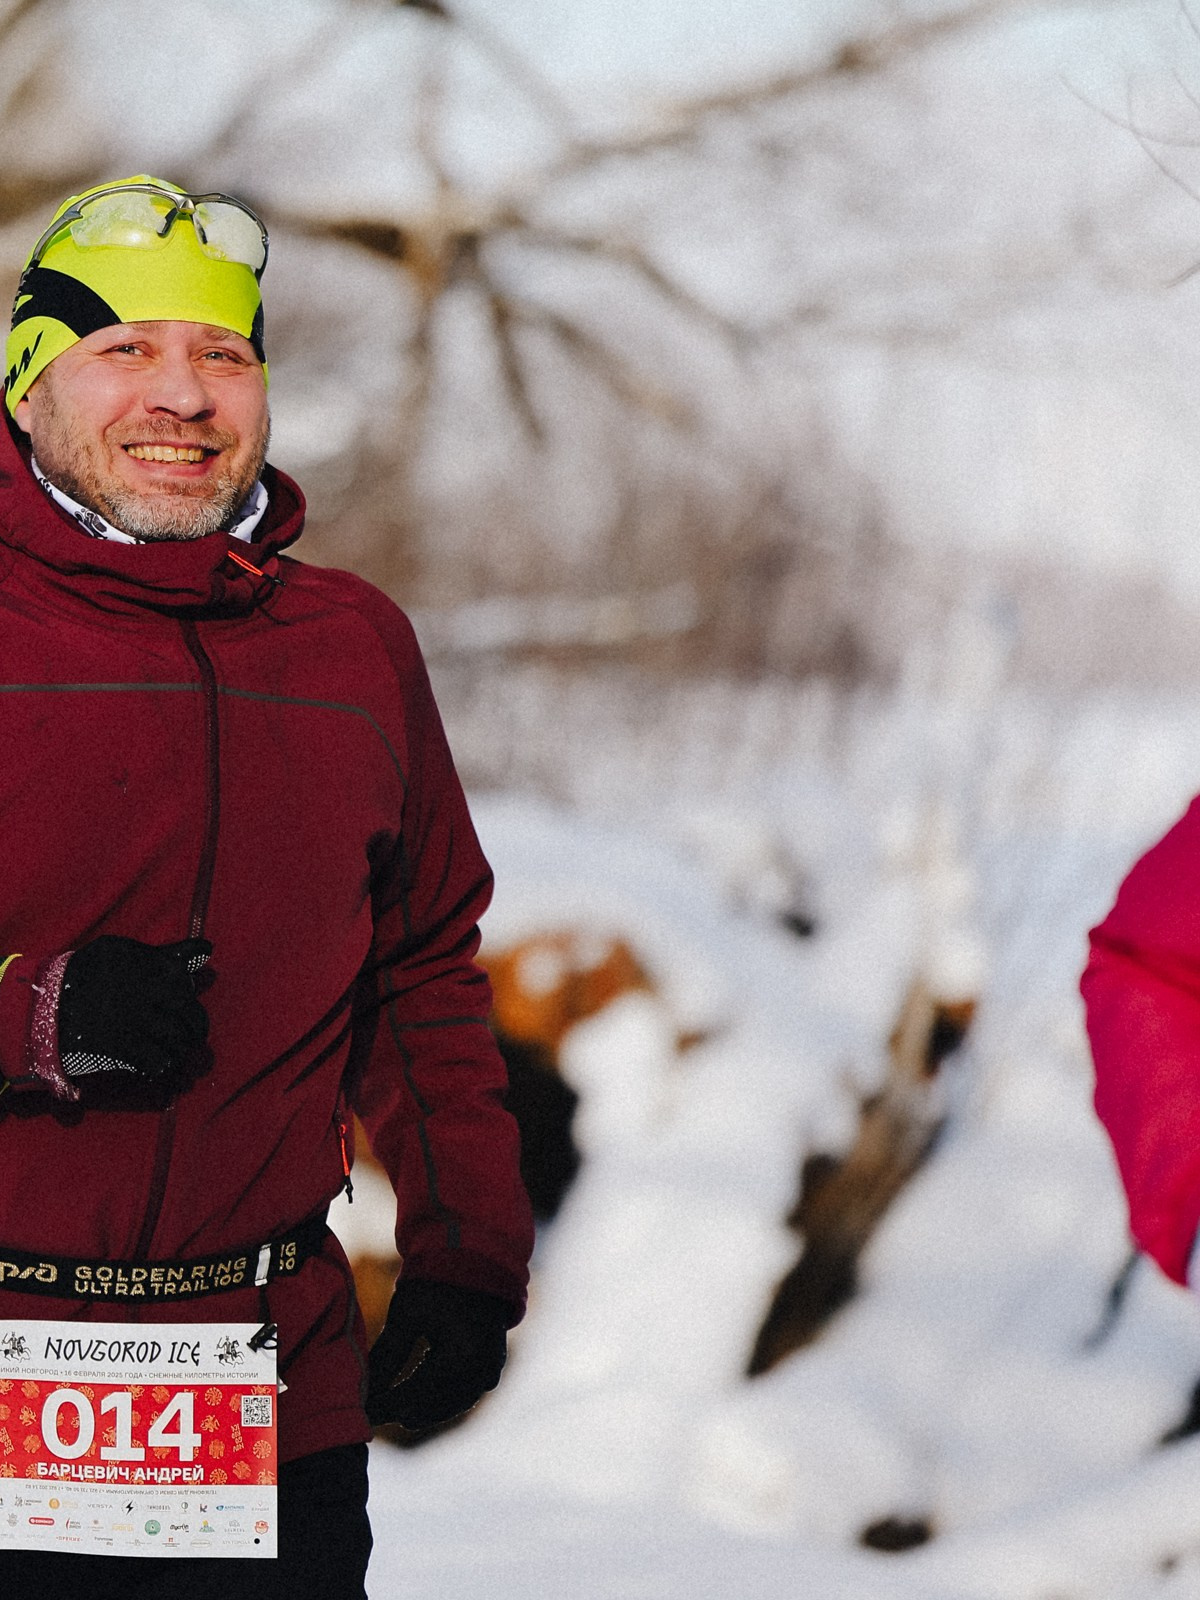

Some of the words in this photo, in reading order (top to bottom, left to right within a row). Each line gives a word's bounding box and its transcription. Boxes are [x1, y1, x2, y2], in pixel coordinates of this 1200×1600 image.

[75, 1266, 184, 1282] GOLDEN
[191, 1257, 247, 1280] RING
[74, 1280, 146, 1296] ULTRA
[150, 1279, 210, 1296] TRAIL
[214, 1272, 244, 1287] 100
[44, 1336, 162, 1363] NOVGOROD
[168, 1341, 200, 1366] ICE
[22, 1368, 58, 1376] НОВГОРОД
[41, 1388, 202, 1462] 014
[37, 1462, 130, 1481] БАРЦЕВИЧ
[134, 1465, 204, 1484] АНДРЕЙ
